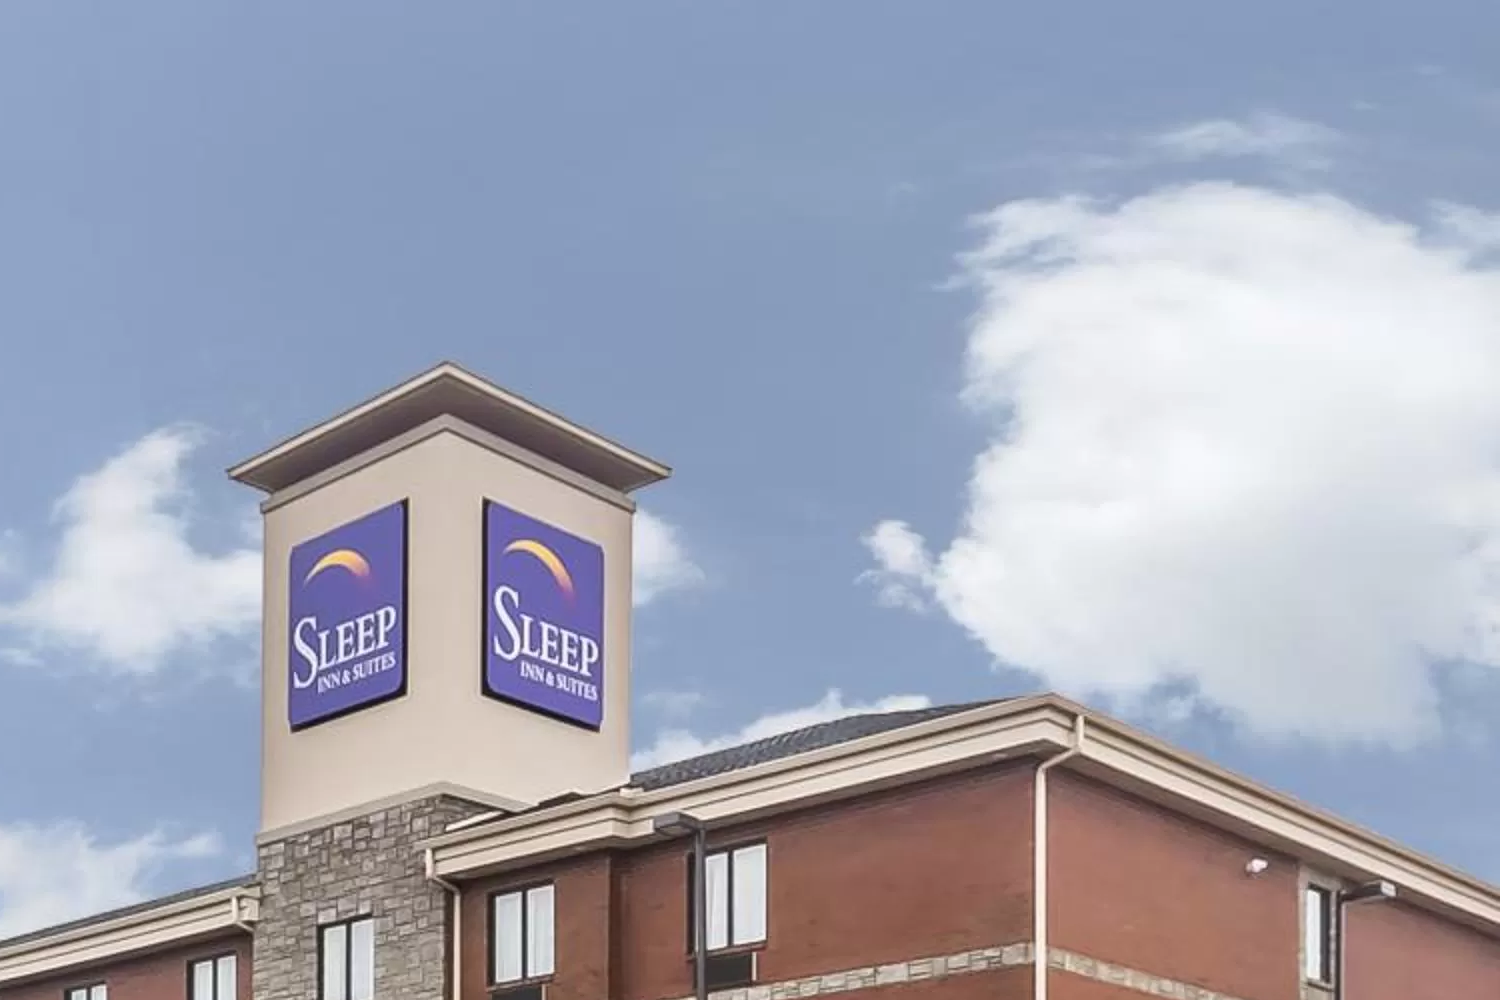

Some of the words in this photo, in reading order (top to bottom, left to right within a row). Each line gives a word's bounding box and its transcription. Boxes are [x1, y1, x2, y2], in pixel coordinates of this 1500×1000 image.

[293, 606, 396, 689] SLEEP
[494, 585, 599, 677] SLEEP
[318, 669, 341, 693] INN
[342, 668, 351, 685] &
[352, 651, 396, 681] SUITES
[520, 660, 544, 683] INN
[546, 671, 555, 687] &
[556, 673, 598, 701] SUITES
